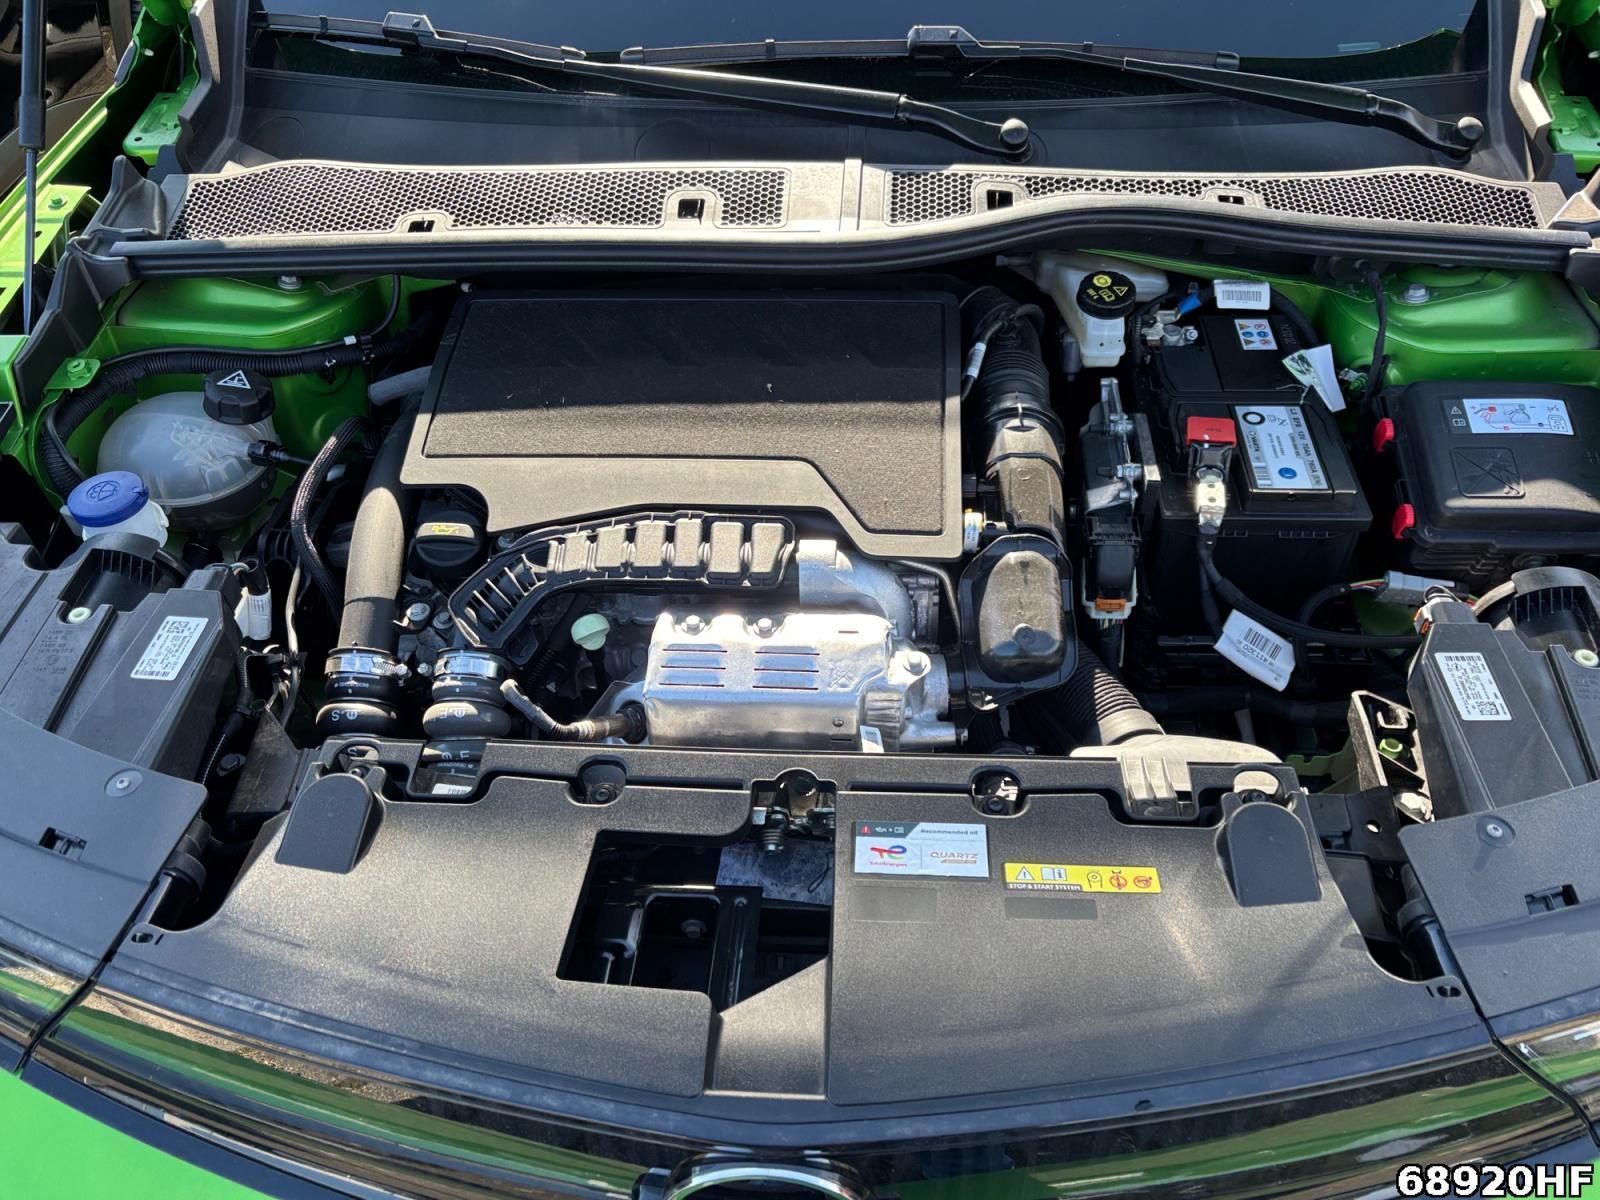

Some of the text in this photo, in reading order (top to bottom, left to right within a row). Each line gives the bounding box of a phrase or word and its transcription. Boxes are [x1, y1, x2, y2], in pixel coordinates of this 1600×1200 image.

[1298, 431, 1306, 439] 12V
[920, 828, 968, 836] Recommended
[930, 851, 978, 859] QUARTZ
